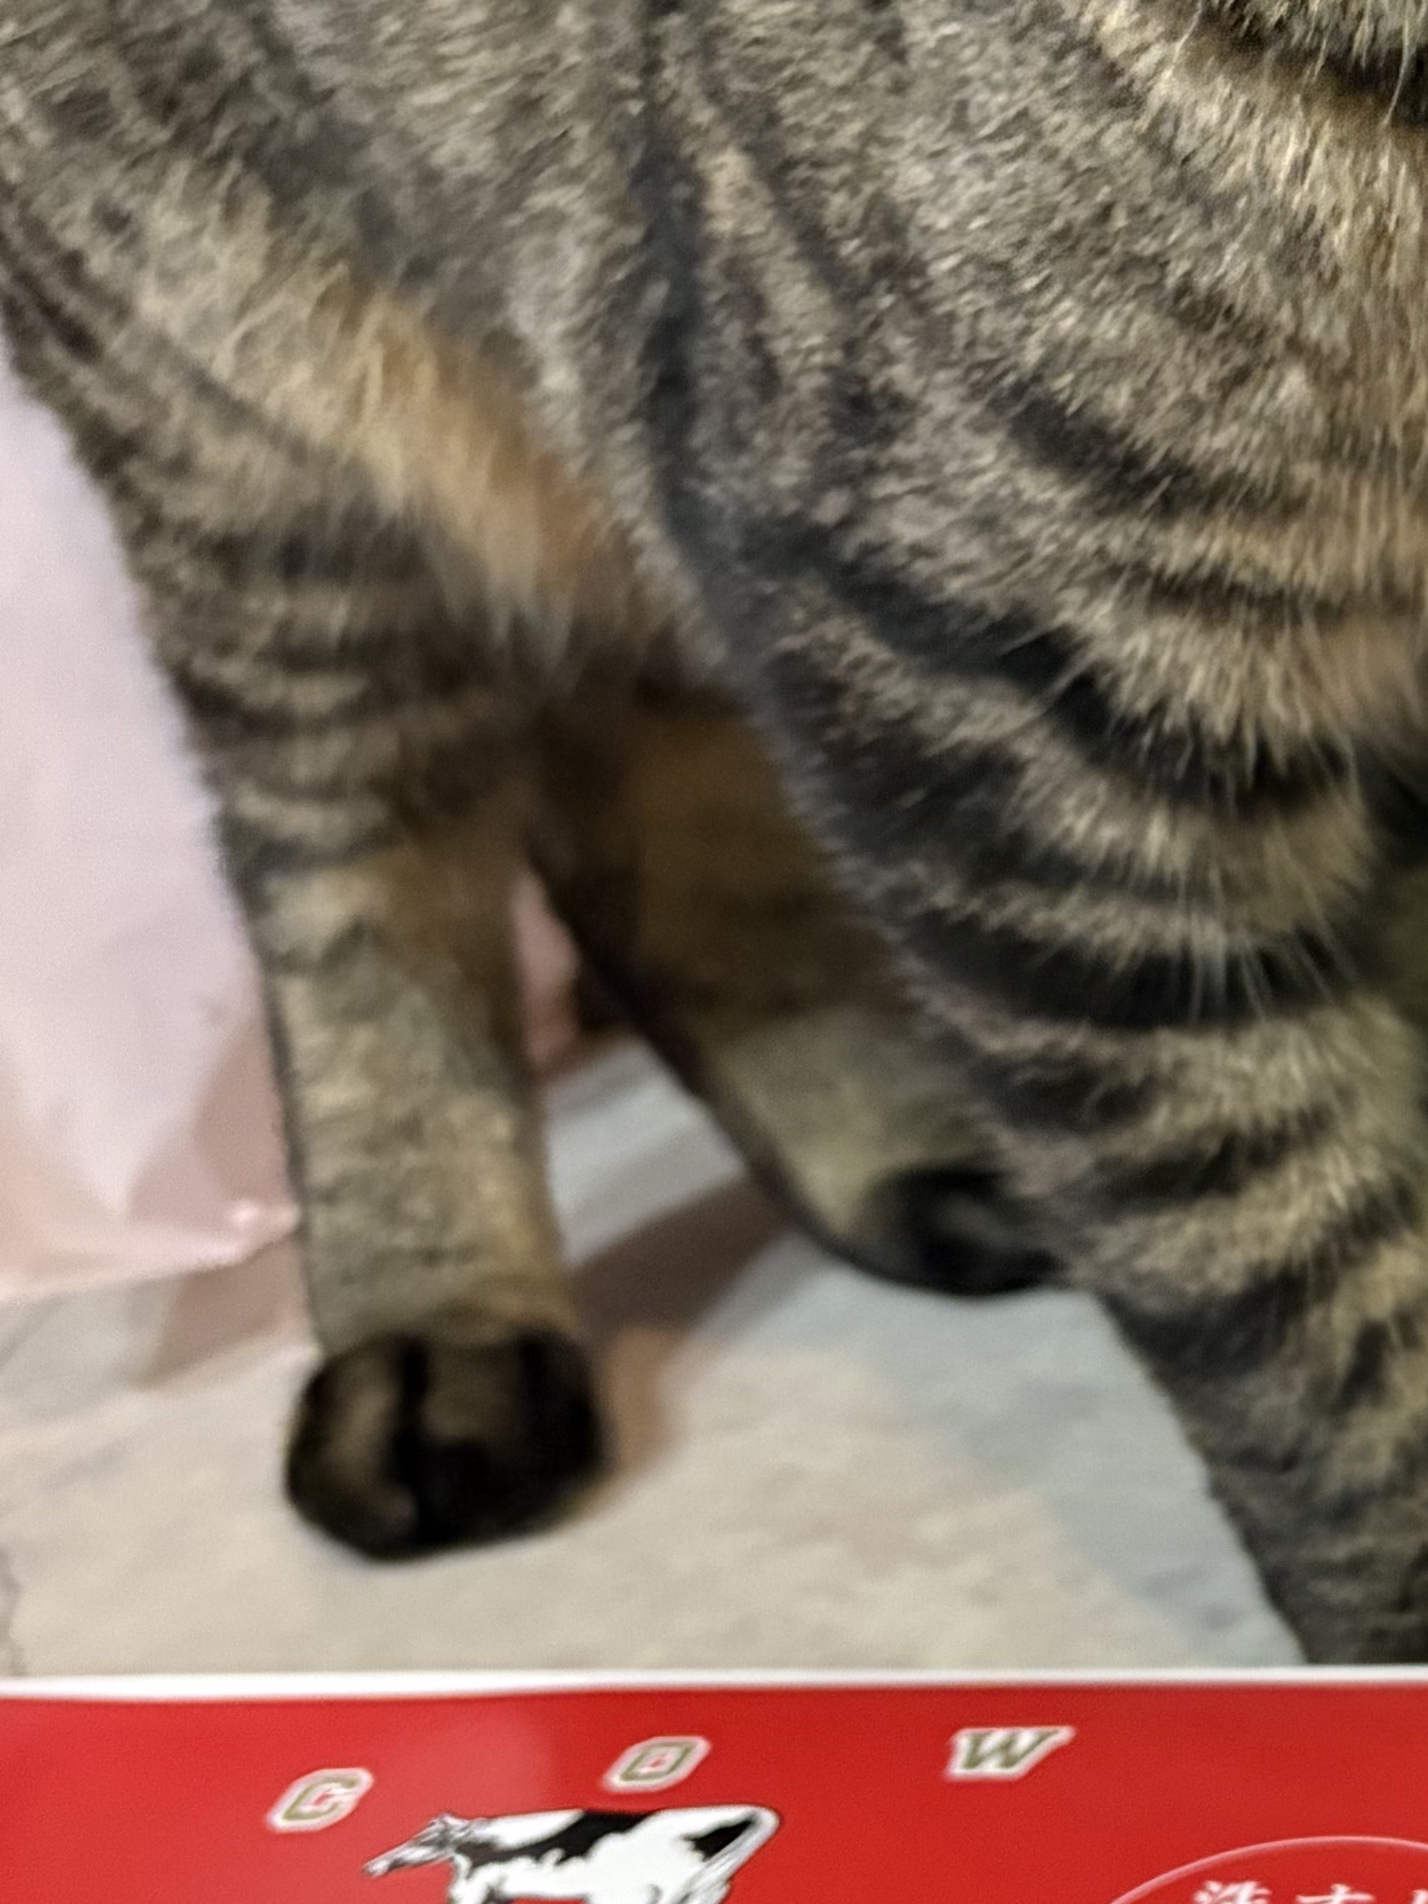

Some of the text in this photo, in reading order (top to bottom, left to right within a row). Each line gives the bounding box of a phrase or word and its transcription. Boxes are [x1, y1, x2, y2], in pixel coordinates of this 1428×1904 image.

[266, 1726, 1075, 1833] C O W
